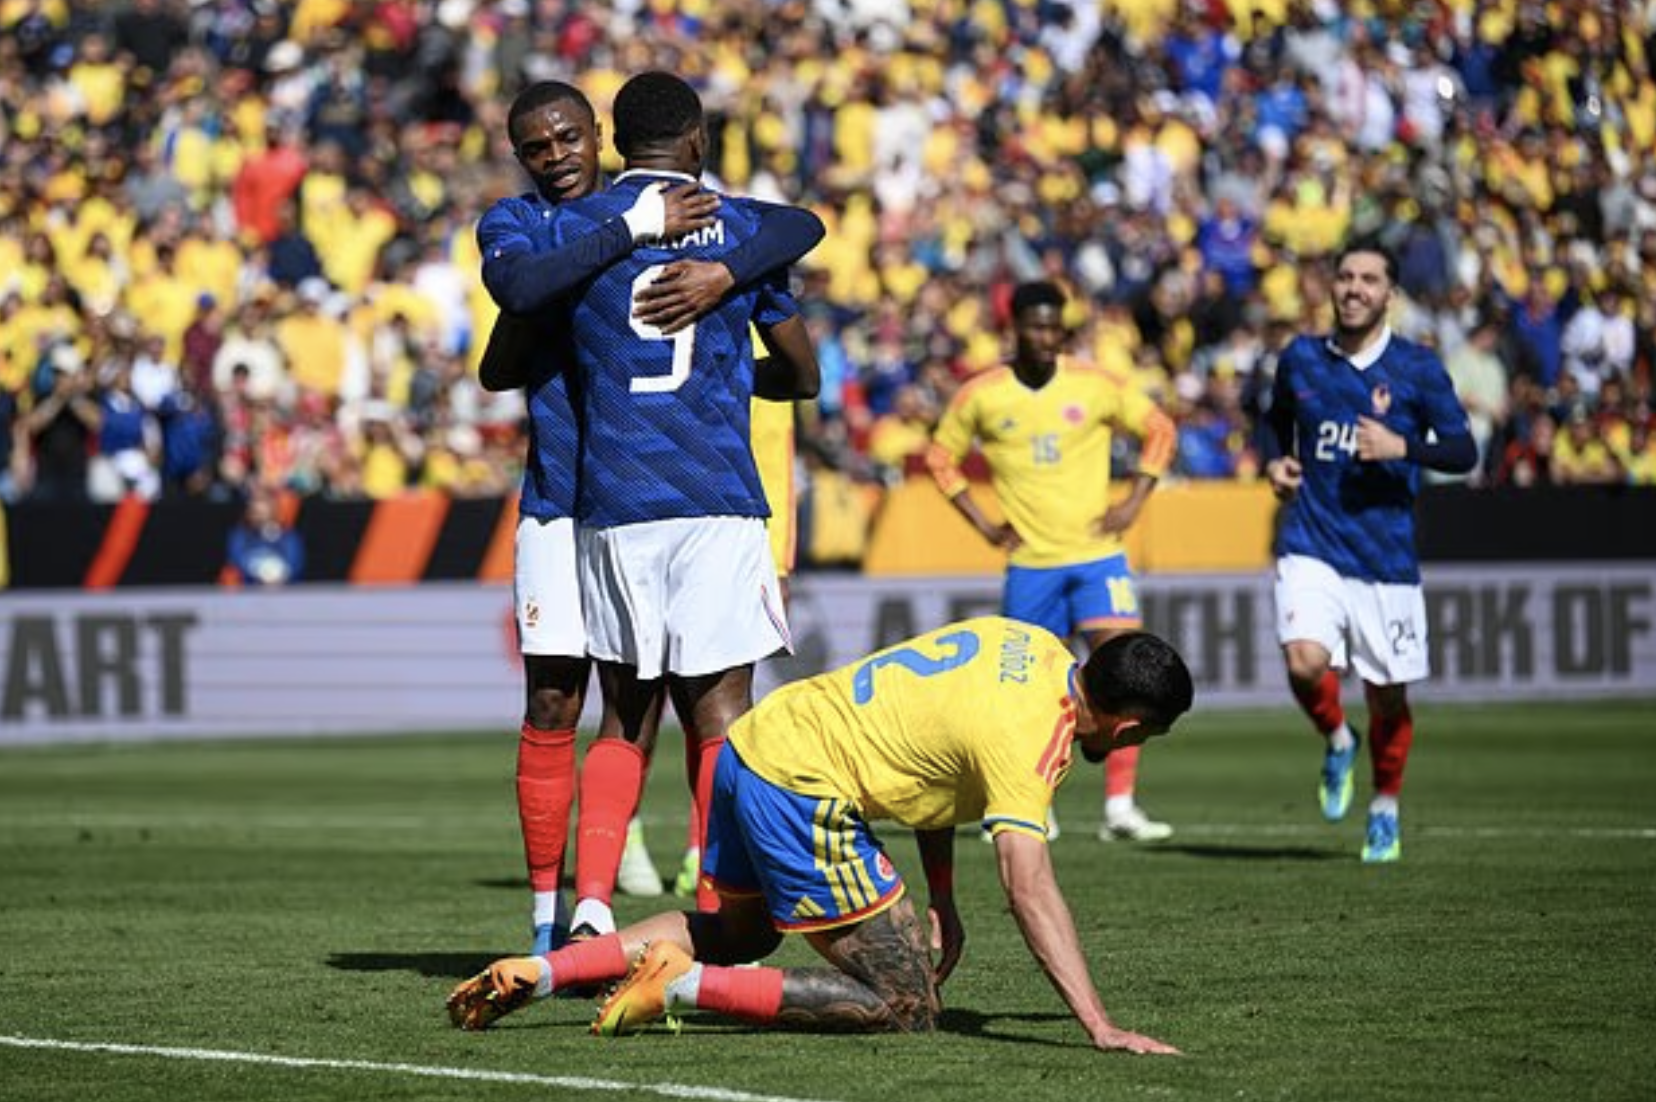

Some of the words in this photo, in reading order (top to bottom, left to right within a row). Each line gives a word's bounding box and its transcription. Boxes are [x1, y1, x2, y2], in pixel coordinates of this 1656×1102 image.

[629, 263, 696, 392] 9
[1315, 420, 1359, 462] 24
[2, 613, 199, 721] ART
[853, 630, 981, 706] 2
[1428, 585, 1536, 678] RK
[1553, 583, 1651, 676] OF
